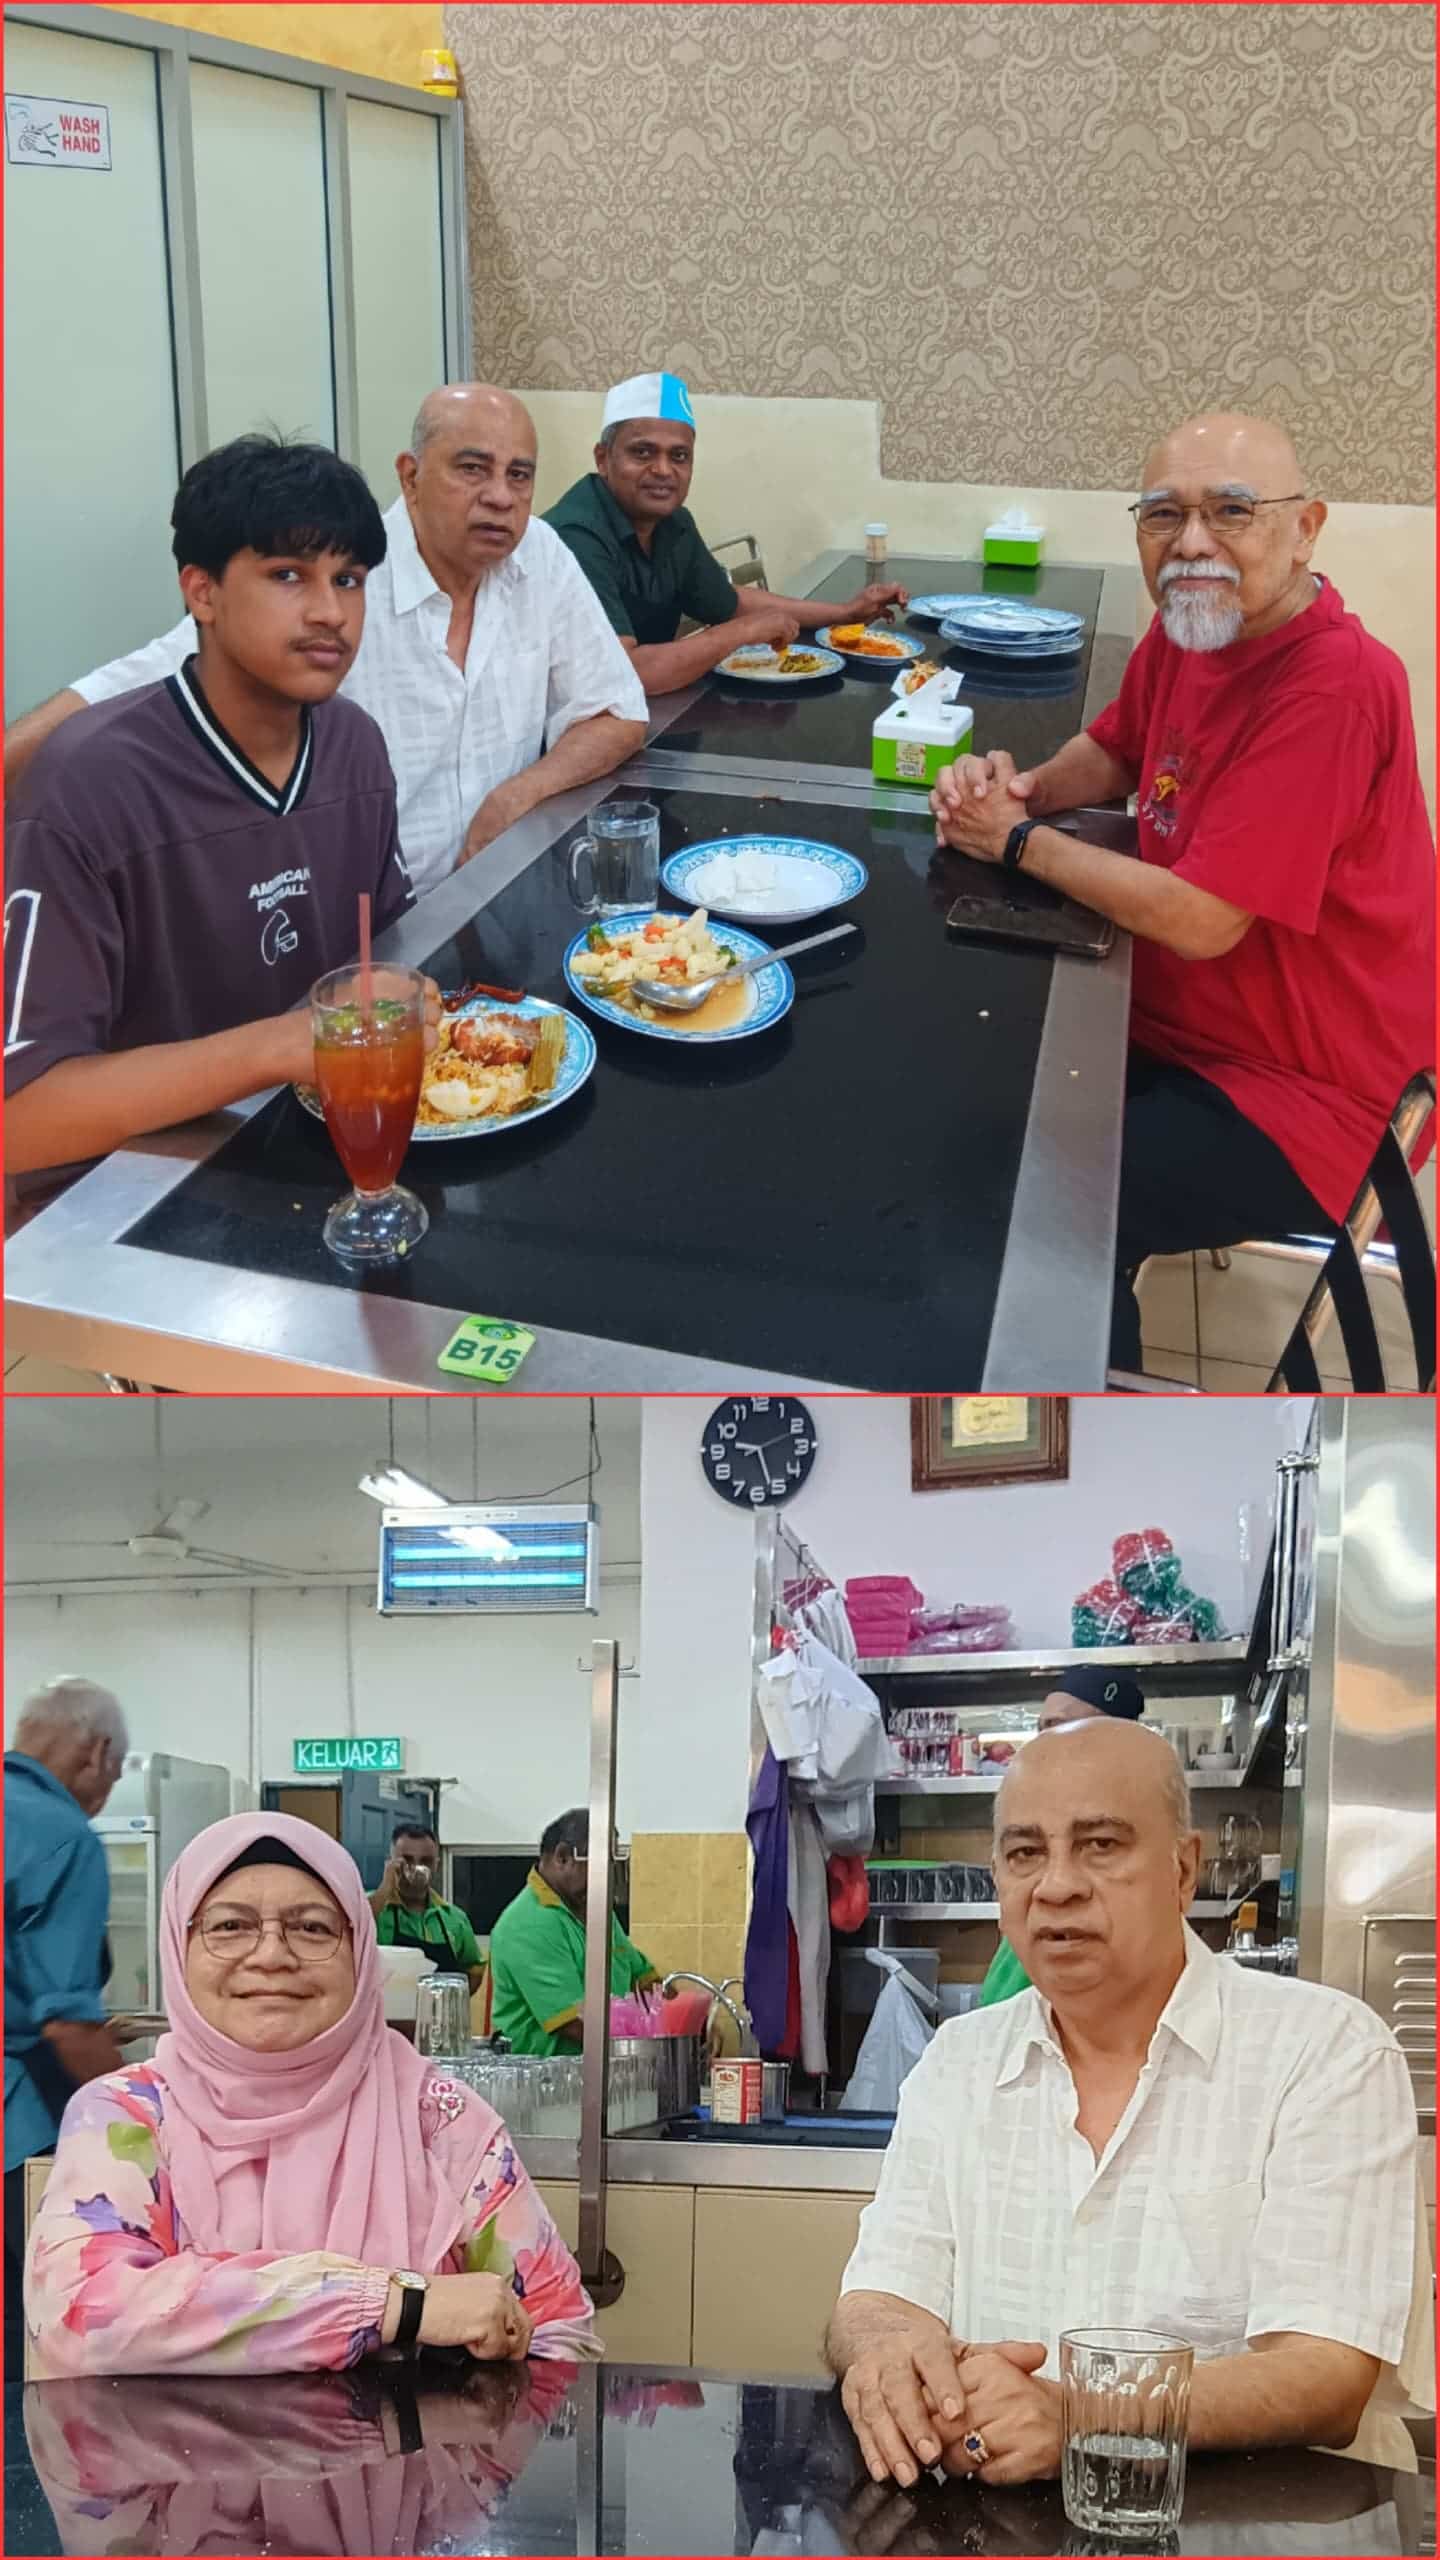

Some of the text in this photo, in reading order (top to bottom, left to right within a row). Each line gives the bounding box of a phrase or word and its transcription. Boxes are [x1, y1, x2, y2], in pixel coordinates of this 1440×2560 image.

[60, 114, 100, 134] WASH
[62, 135, 100, 153] HAND
[447, 1338, 521, 1370] B15
[733, 1404, 747, 1421] 11
[751, 1396, 770, 1412] 12
[779, 1402, 785, 1419] 1
[717, 1422, 737, 1440] 10
[790, 1417, 804, 1435] 2
[710, 1443, 725, 1461] 9
[794, 1438, 809, 1456] 3
[715, 1463, 731, 1481] 8
[786, 1460, 801, 1479] 4
[732, 1480, 746, 1497] 7
[749, 1486, 766, 1503] 6
[771, 1479, 786, 1495] 5
[297, 1741, 378, 1768] KELUAR
